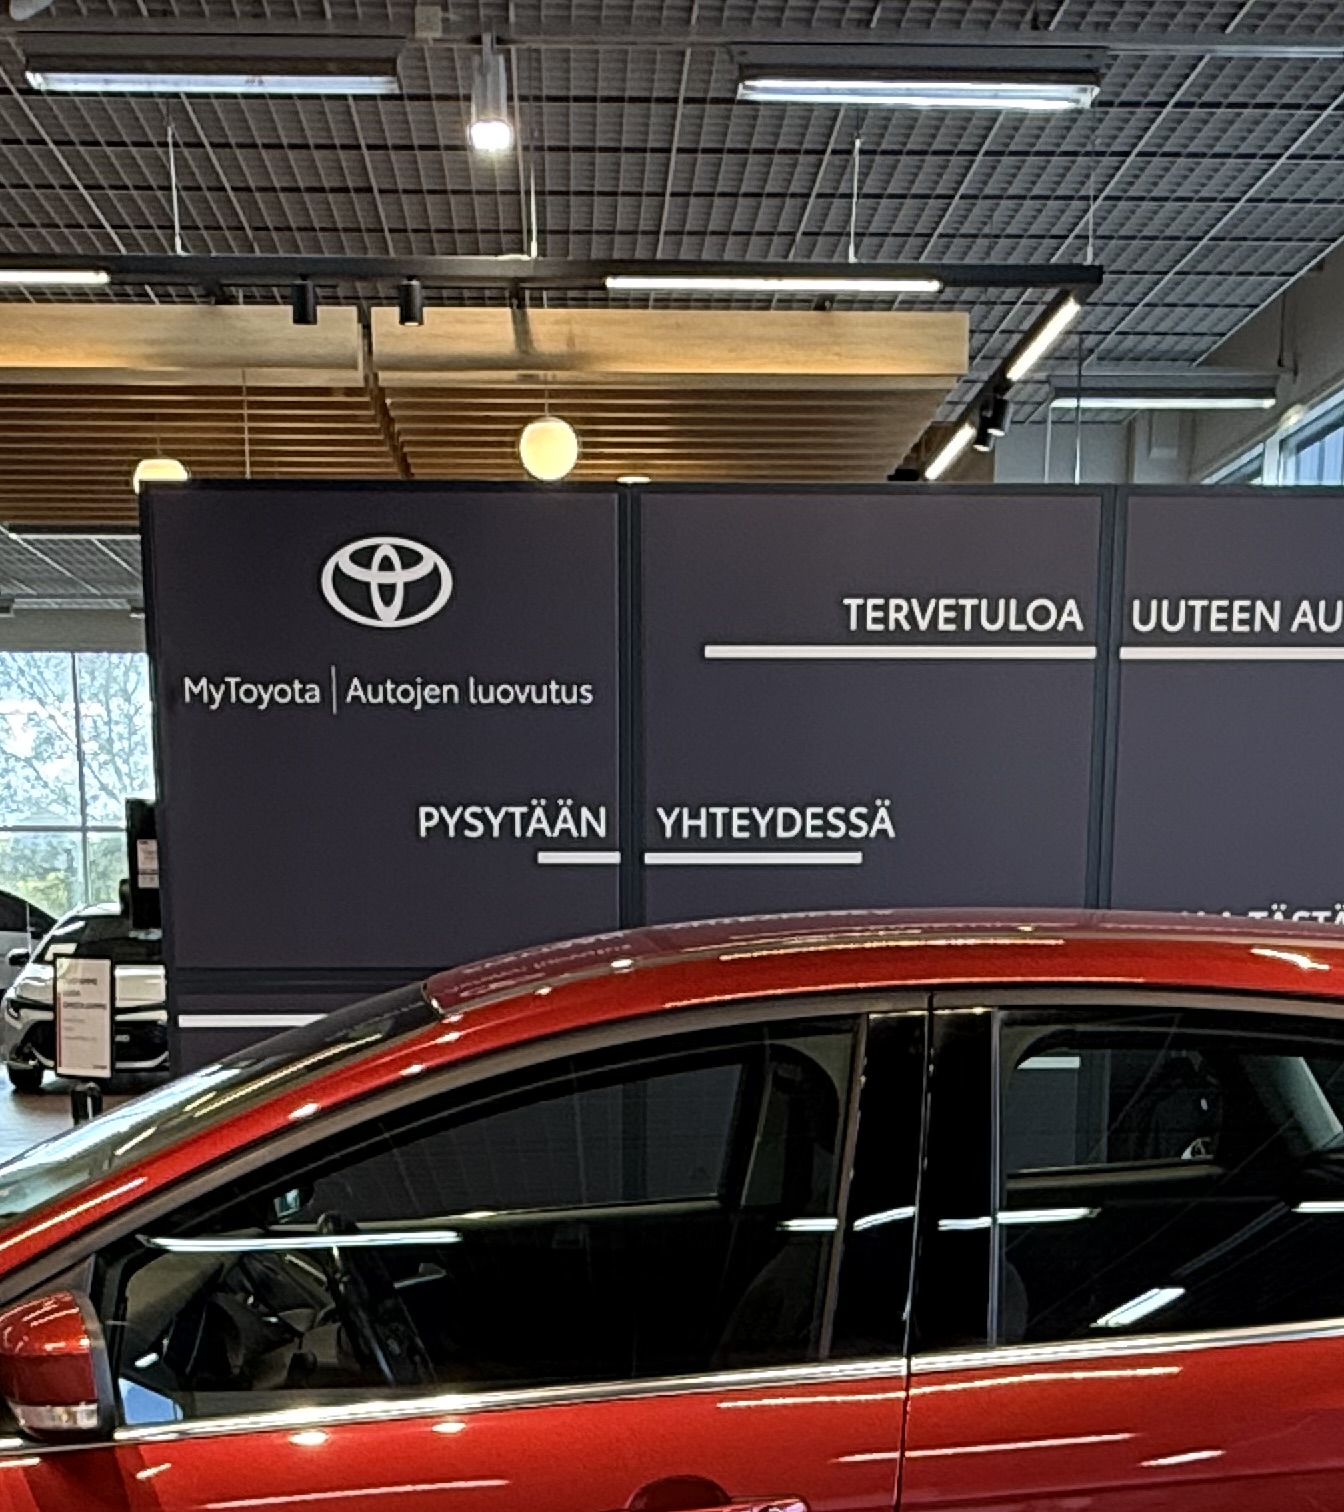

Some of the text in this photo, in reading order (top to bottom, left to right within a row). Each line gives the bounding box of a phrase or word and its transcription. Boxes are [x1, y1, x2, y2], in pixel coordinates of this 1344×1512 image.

[842, 598, 1084, 633] TERVETULOA
[1131, 598, 1282, 633] UUTEEN
[183, 676, 595, 710] MyToyota Autojen luovutus
[418, 798, 897, 839] PYSYTÄÄN YHTEYDESSÄ
